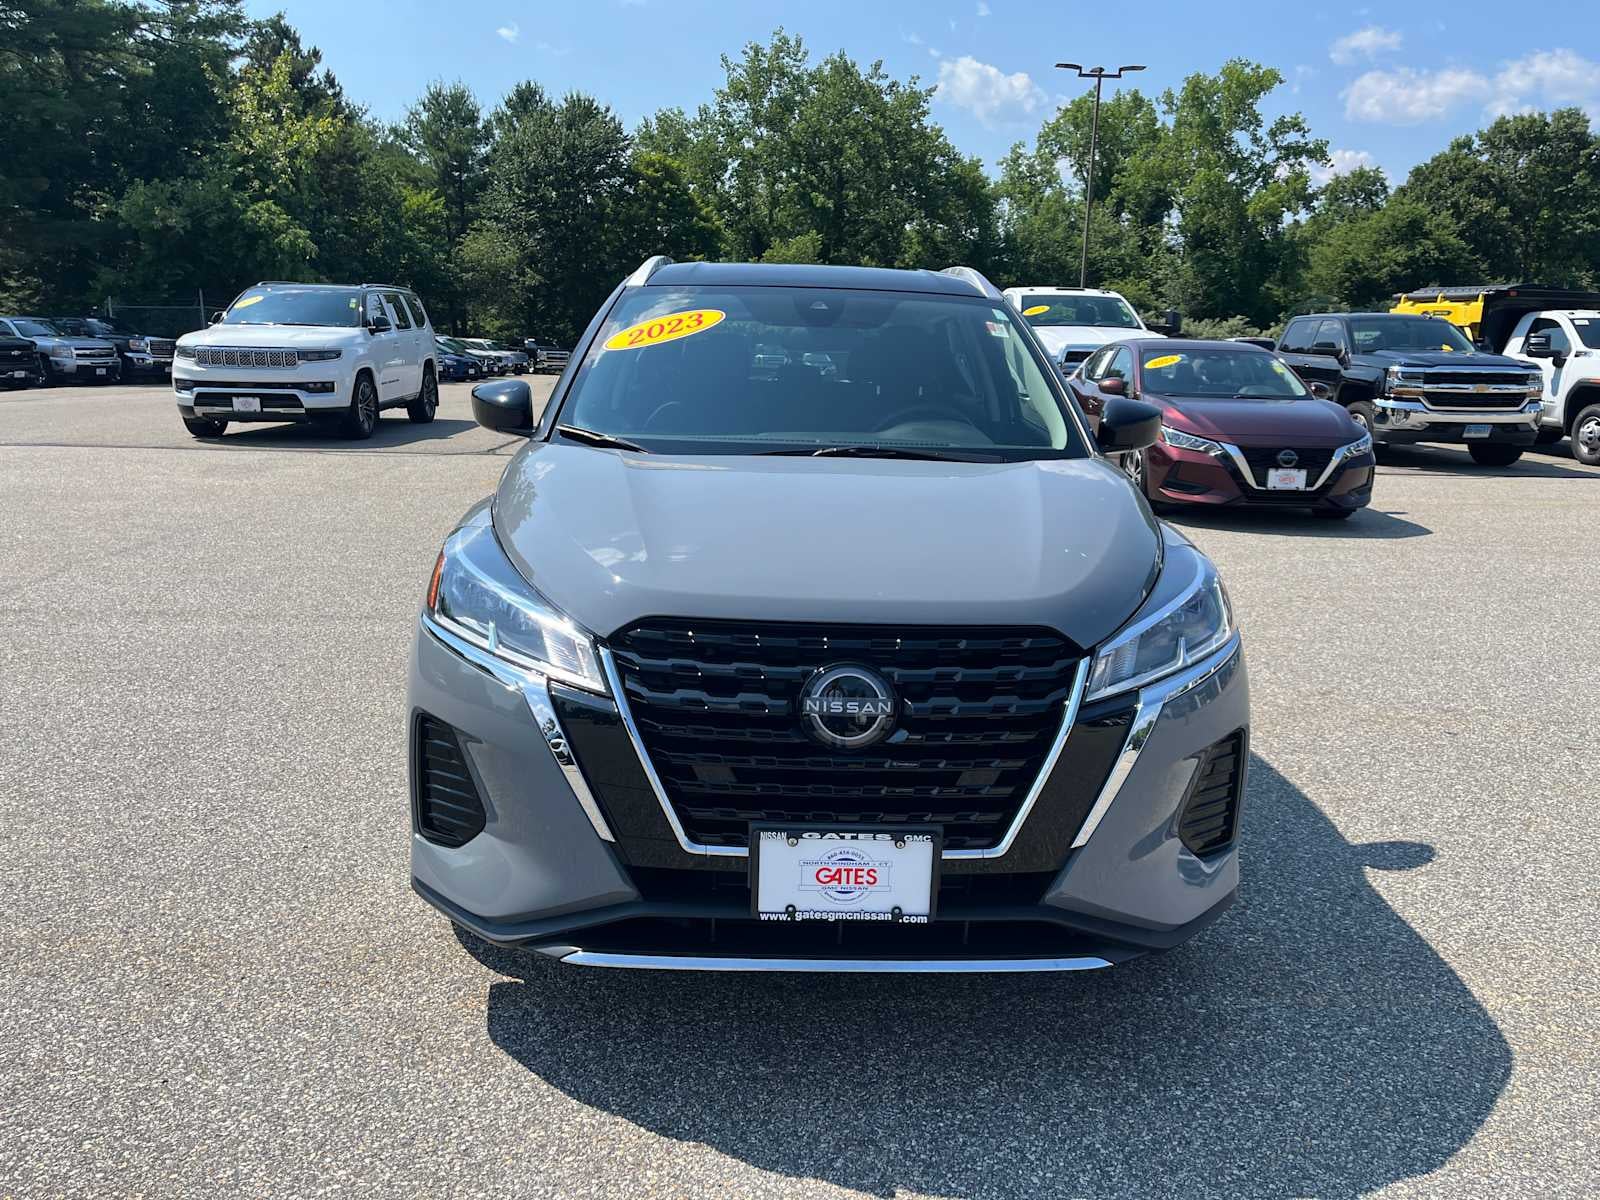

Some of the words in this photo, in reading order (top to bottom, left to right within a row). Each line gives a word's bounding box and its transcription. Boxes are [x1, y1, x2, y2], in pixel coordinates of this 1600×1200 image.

[627, 312, 704, 346] 2023
[806, 700, 891, 713] NISSAN
[760, 831, 787, 840] NISSAN
[801, 832, 892, 841] GATES
[903, 834, 932, 842] GMC
[815, 867, 878, 885] GATES
